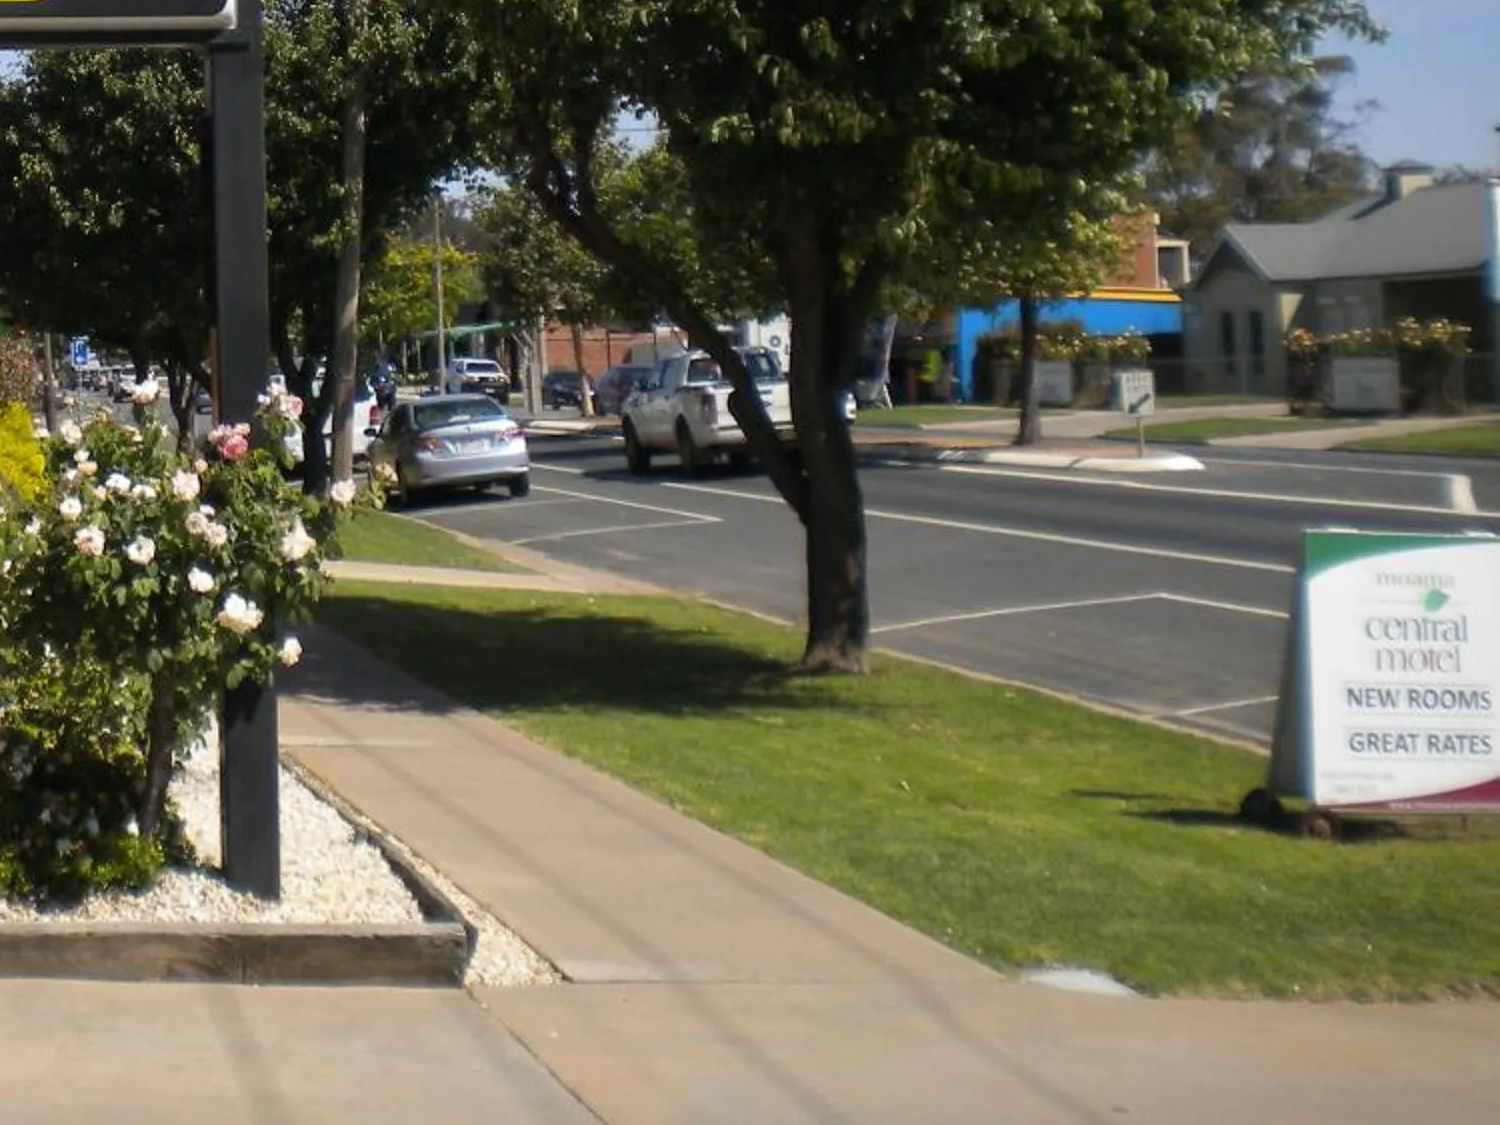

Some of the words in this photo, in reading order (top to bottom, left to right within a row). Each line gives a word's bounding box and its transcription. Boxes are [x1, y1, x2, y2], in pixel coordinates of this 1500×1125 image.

[1364, 614, 1469, 643] central
[1375, 646, 1462, 673] motel
[1346, 687, 1400, 709] NEW
[1408, 689, 1492, 711] ROOMS
[1348, 731, 1421, 754] GREAT
[1427, 733, 1493, 755] RATES
